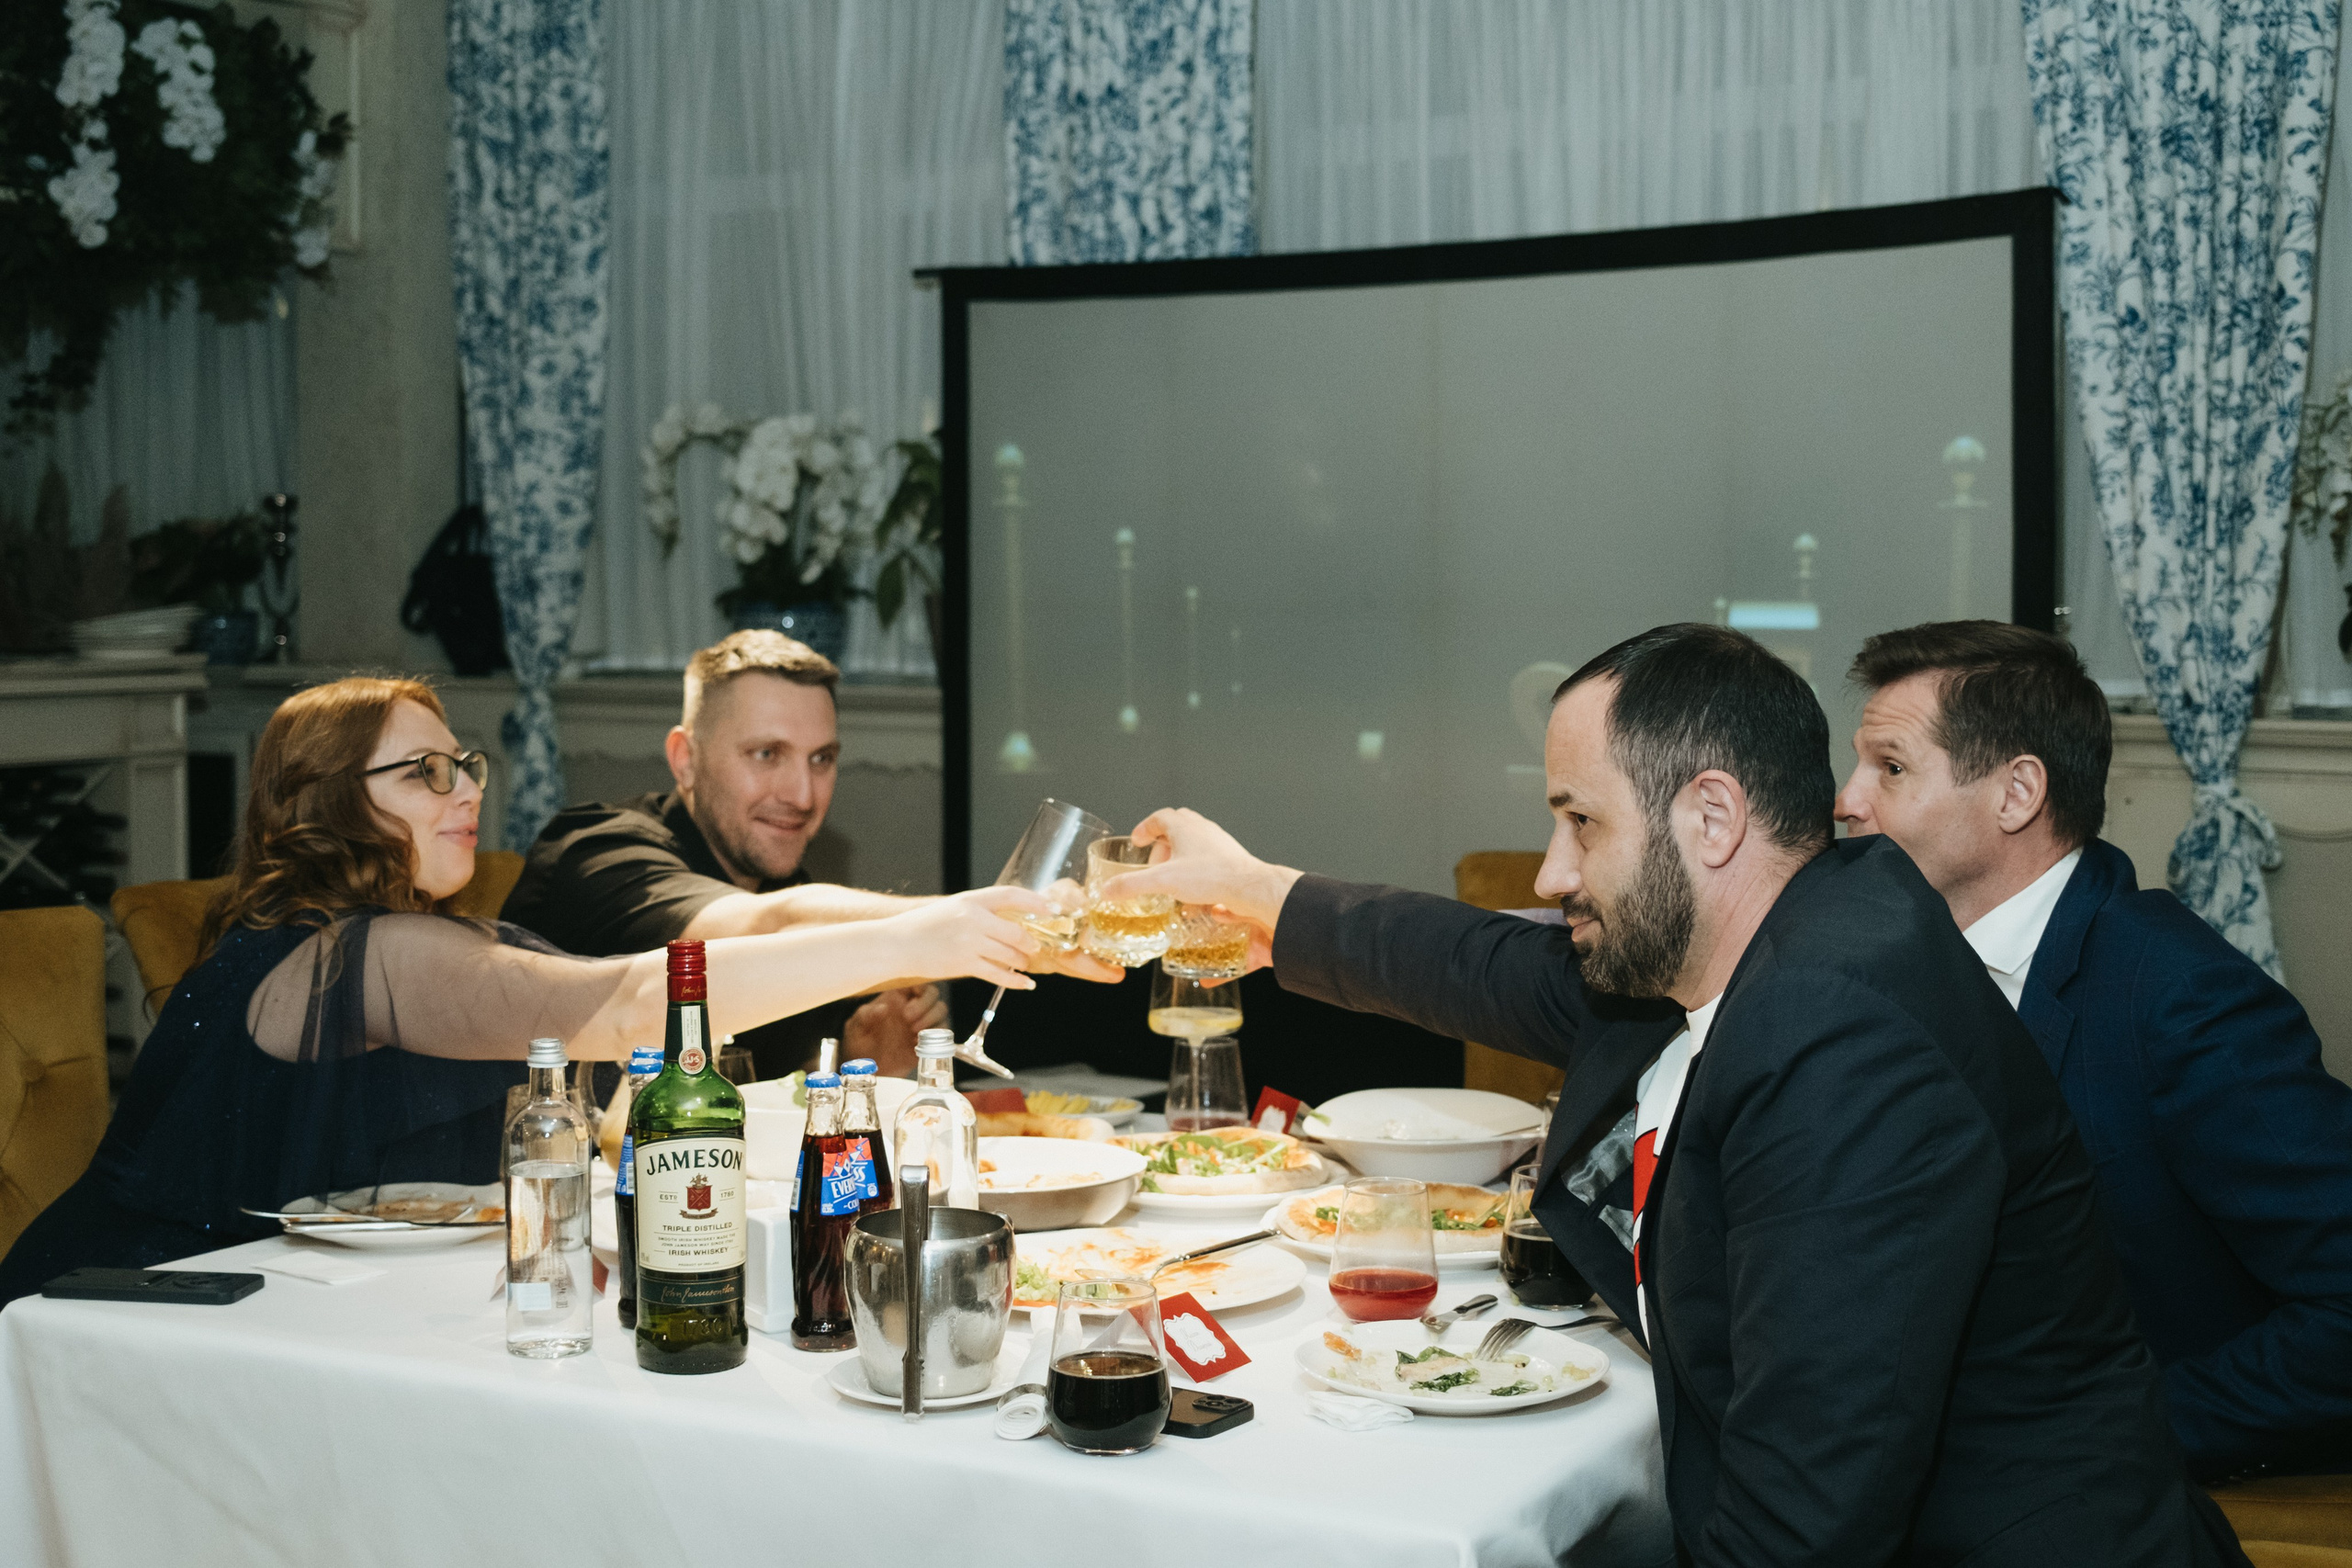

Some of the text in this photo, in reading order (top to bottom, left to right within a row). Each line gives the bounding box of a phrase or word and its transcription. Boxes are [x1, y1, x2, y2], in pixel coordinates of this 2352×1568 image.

[647, 1148, 742, 1176] JAMESON
[720, 1190, 735, 1199] 1780
[662, 1222, 733, 1233] TRIPLE DISTILLED
[694, 1247, 729, 1257] WHISKEY
